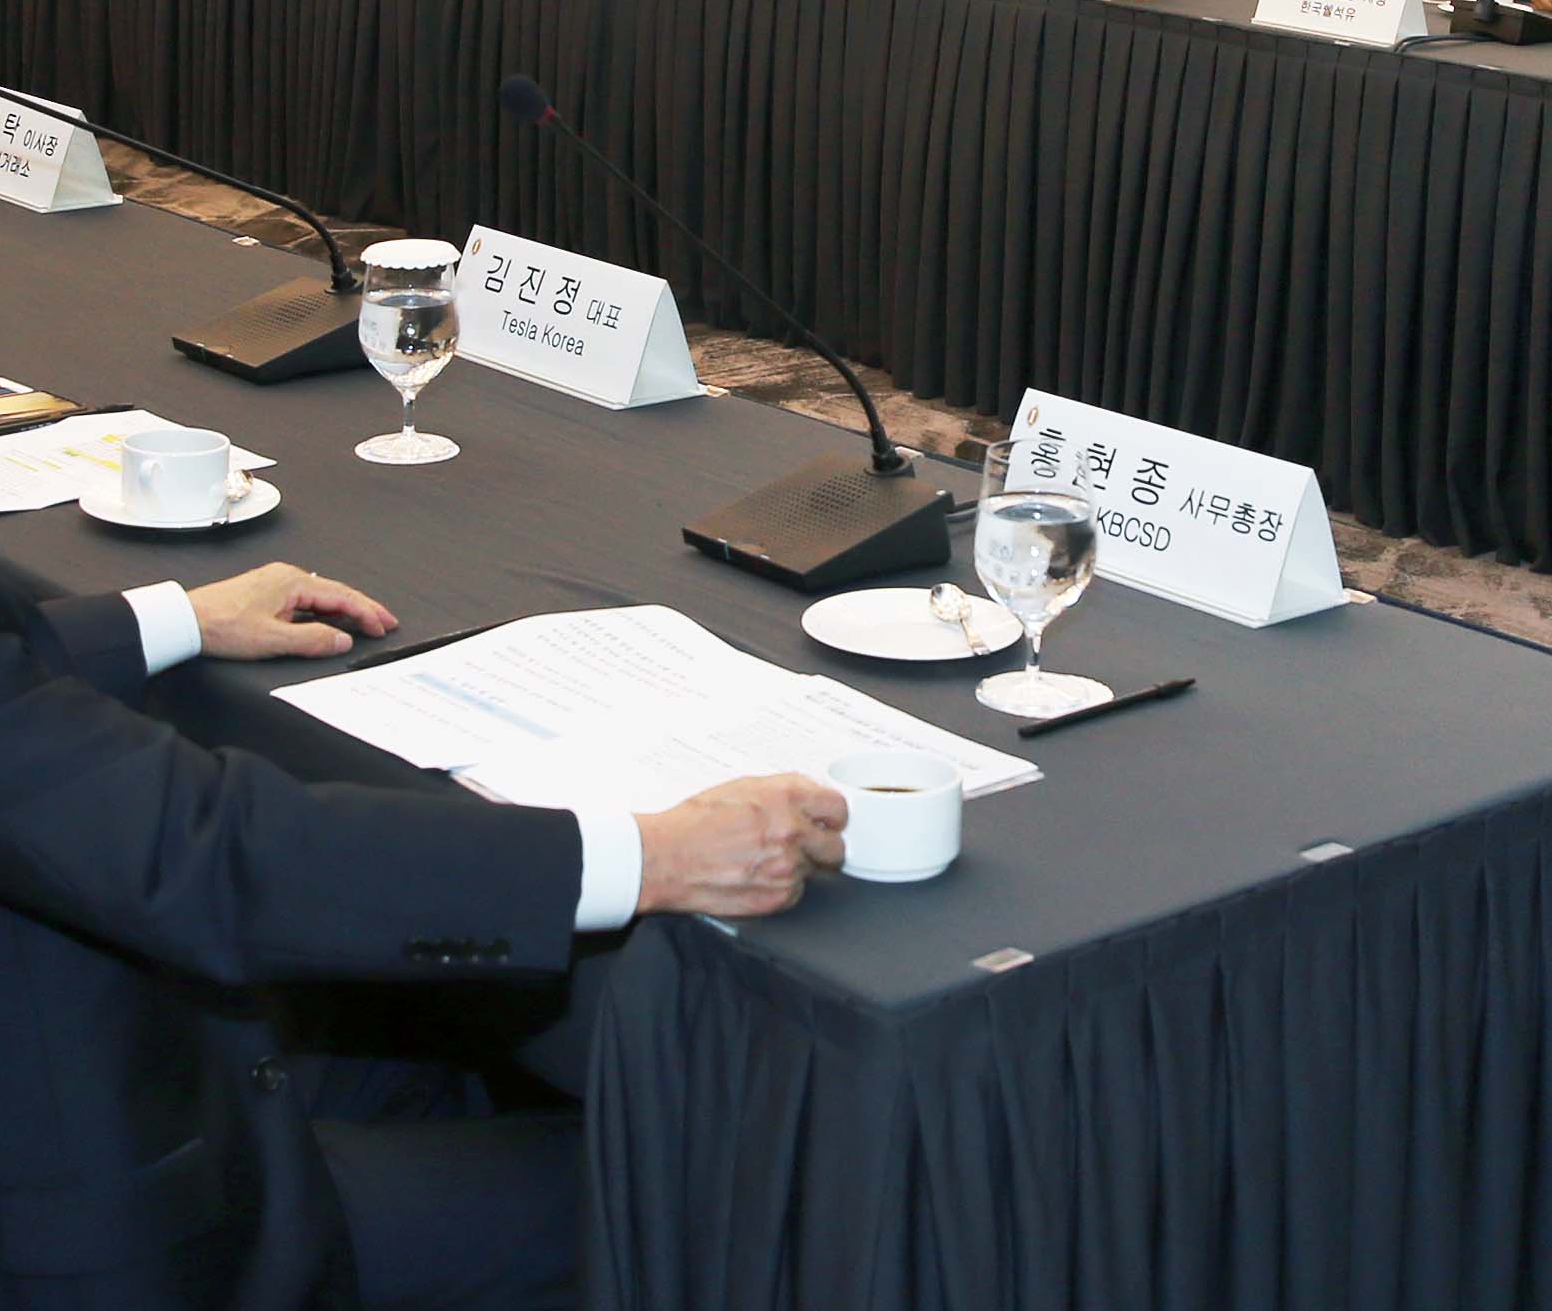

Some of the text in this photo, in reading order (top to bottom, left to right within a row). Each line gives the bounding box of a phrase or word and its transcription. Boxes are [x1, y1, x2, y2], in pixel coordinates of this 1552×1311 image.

[23, 129, 59, 157] 이사장
[501, 309, 585, 357] Tesla Korea
[586, 299, 622, 330] 대표
[1096, 505, 1172, 553] KBCSD
[1179, 488, 1283, 543] 사무총장
